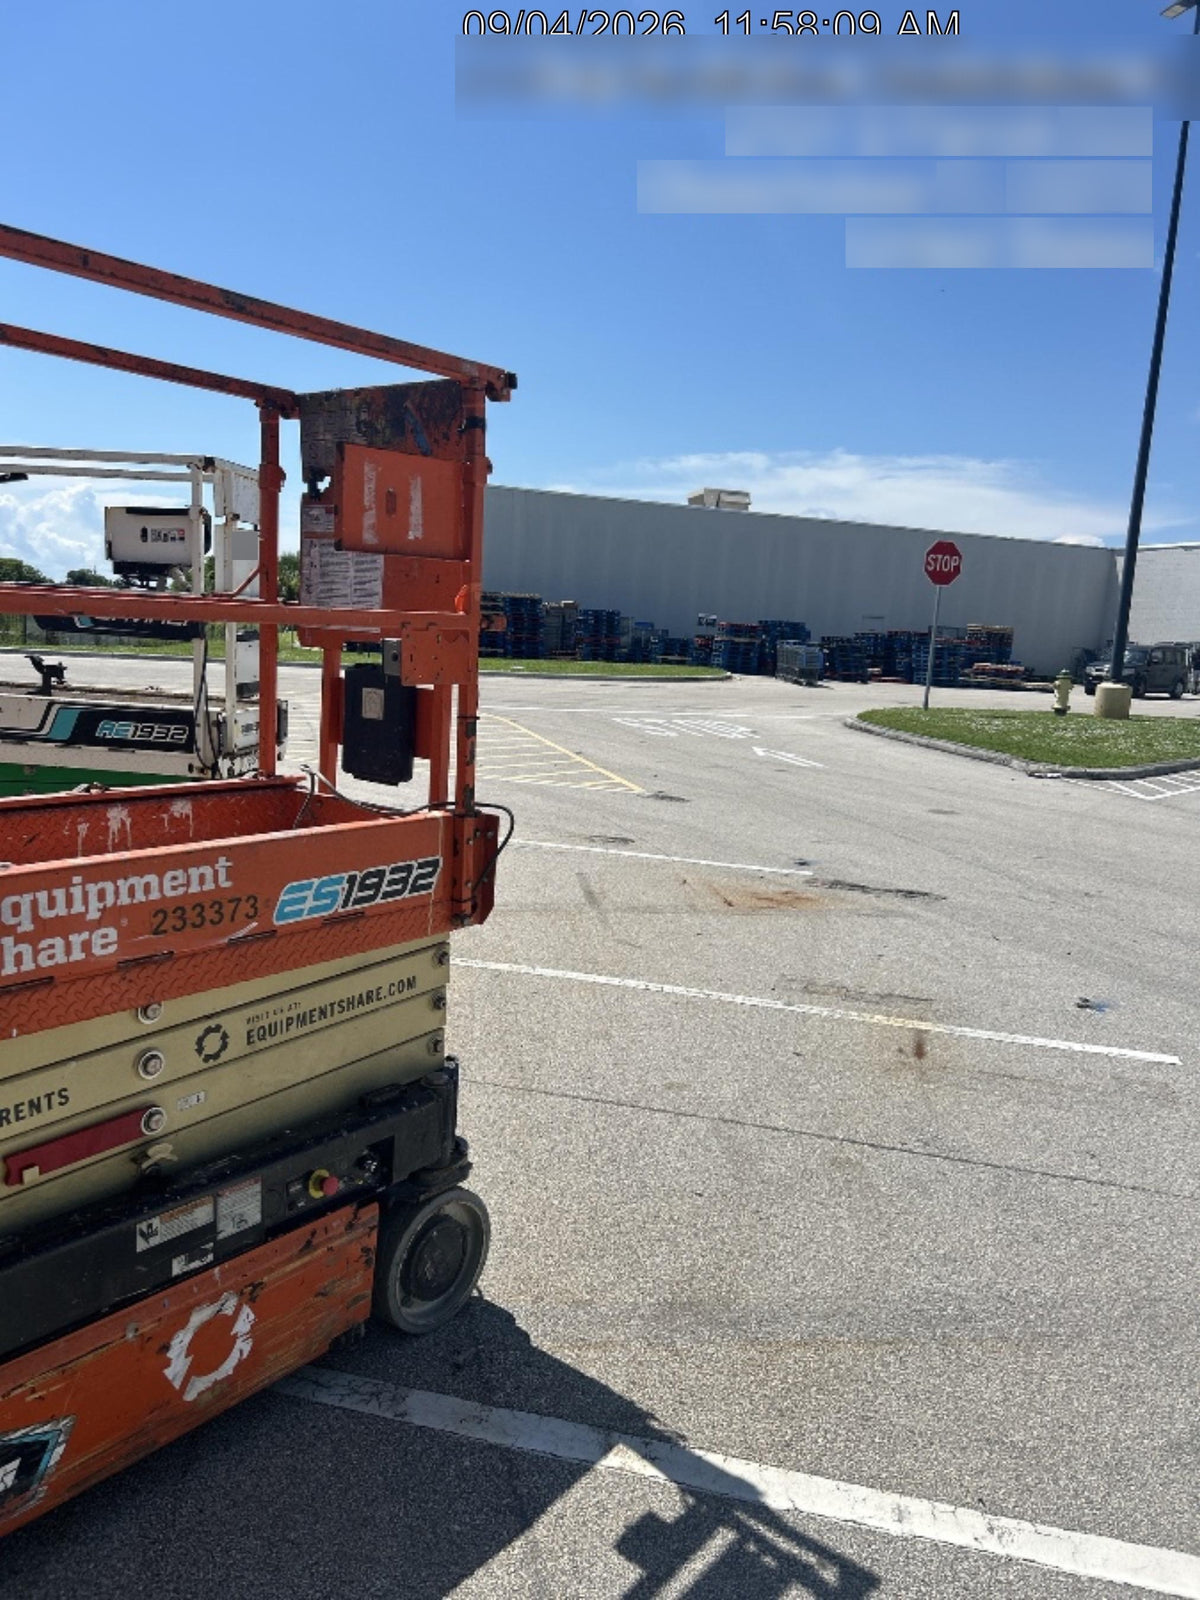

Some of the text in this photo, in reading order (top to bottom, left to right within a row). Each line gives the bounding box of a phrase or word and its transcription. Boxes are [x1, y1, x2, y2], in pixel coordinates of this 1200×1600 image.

[927, 554, 960, 572] STOP
[95, 719, 189, 744] AE1932
[273, 855, 443, 926] ES1932
[151, 894, 260, 936] 233373
[246, 975, 418, 1046] EQUIPMENTSHARE.COM
